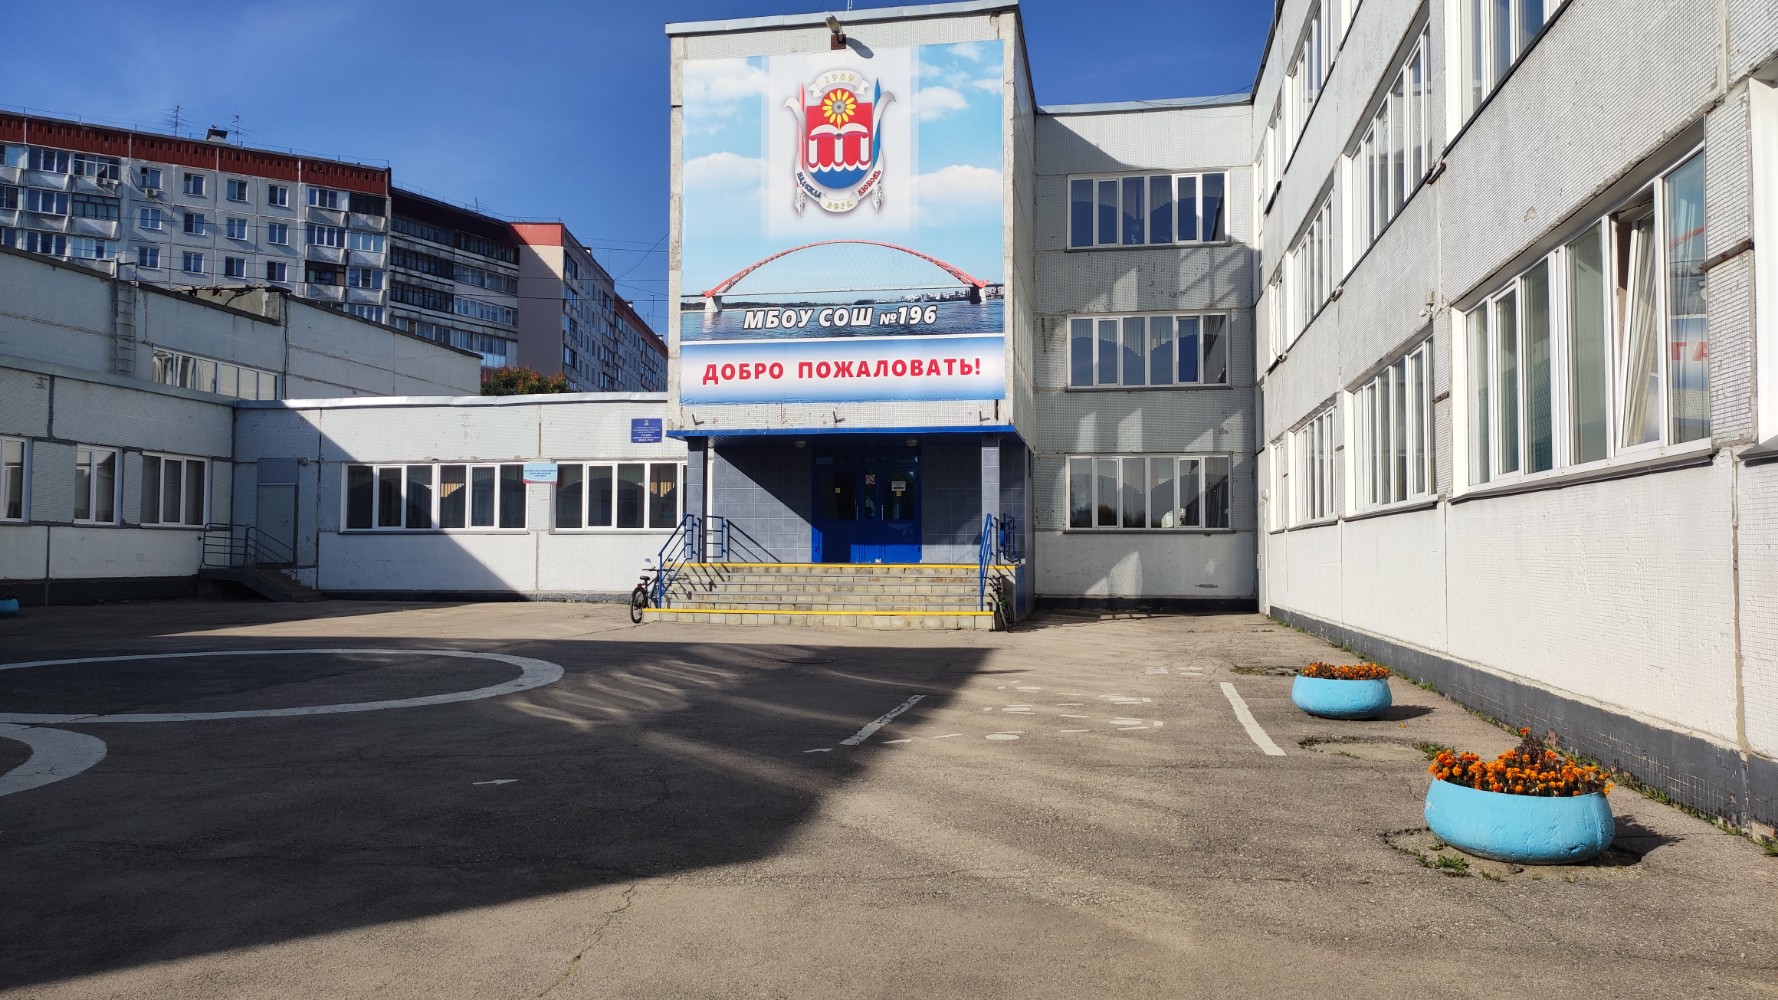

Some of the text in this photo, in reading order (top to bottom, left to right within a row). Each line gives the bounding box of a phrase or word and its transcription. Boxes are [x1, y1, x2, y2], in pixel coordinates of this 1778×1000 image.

[742, 305, 937, 329] МБОУ СОШ №196
[702, 357, 981, 385] ДОБРО ПОЖАЛОВАТЬ!
